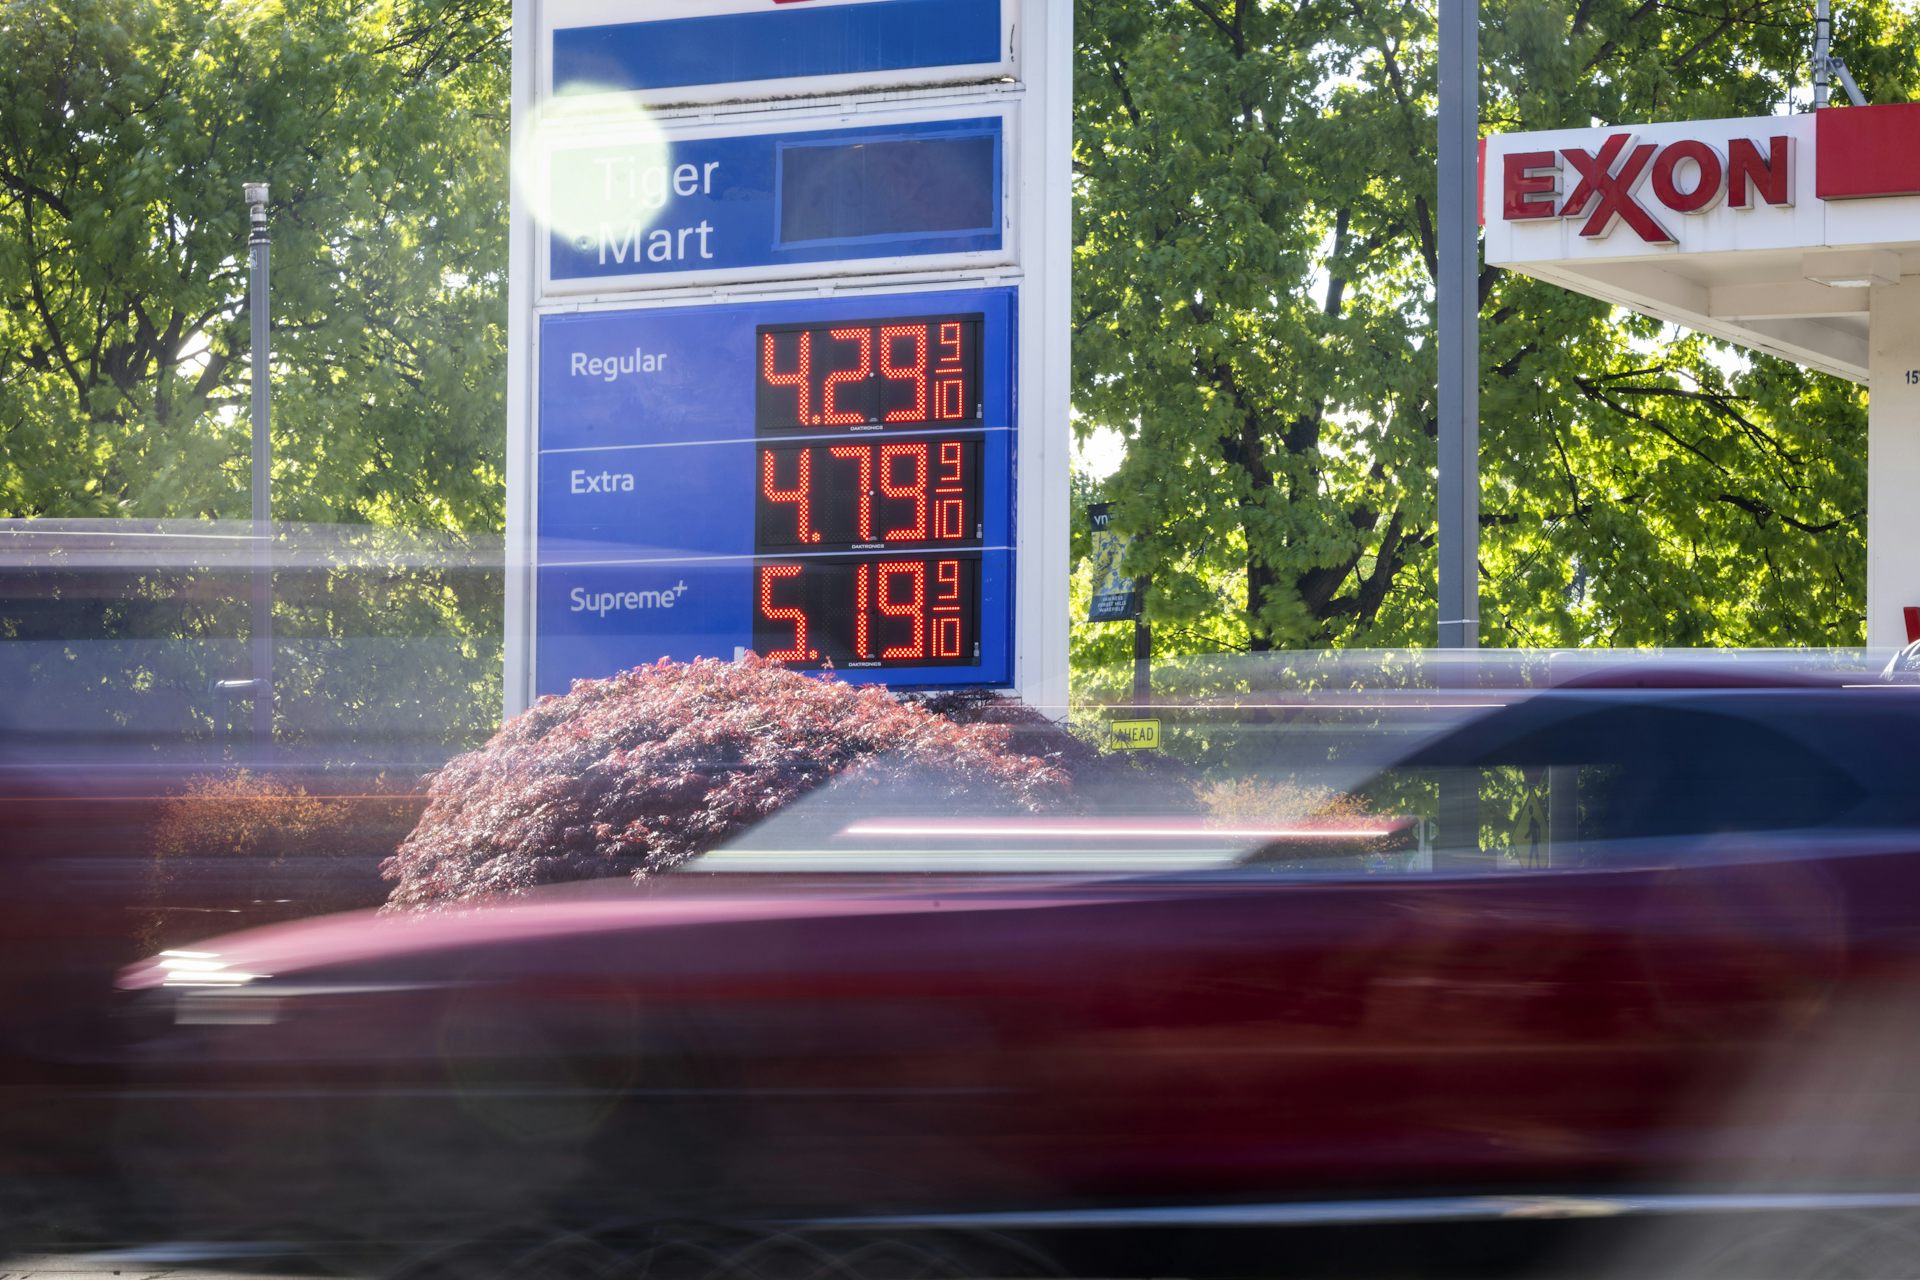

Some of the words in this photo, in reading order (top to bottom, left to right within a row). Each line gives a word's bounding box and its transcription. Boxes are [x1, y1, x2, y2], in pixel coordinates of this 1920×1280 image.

[593, 156, 719, 209] Tiger
[1503, 133, 1797, 244] EXXON
[599, 219, 713, 265] Mart
[571, 347, 667, 382] Regular
[764, 324, 927, 426] 4.29
[571, 469, 634, 494] Extra
[764, 443, 927, 543] 4.79
[761, 561, 924, 661] 5.19
